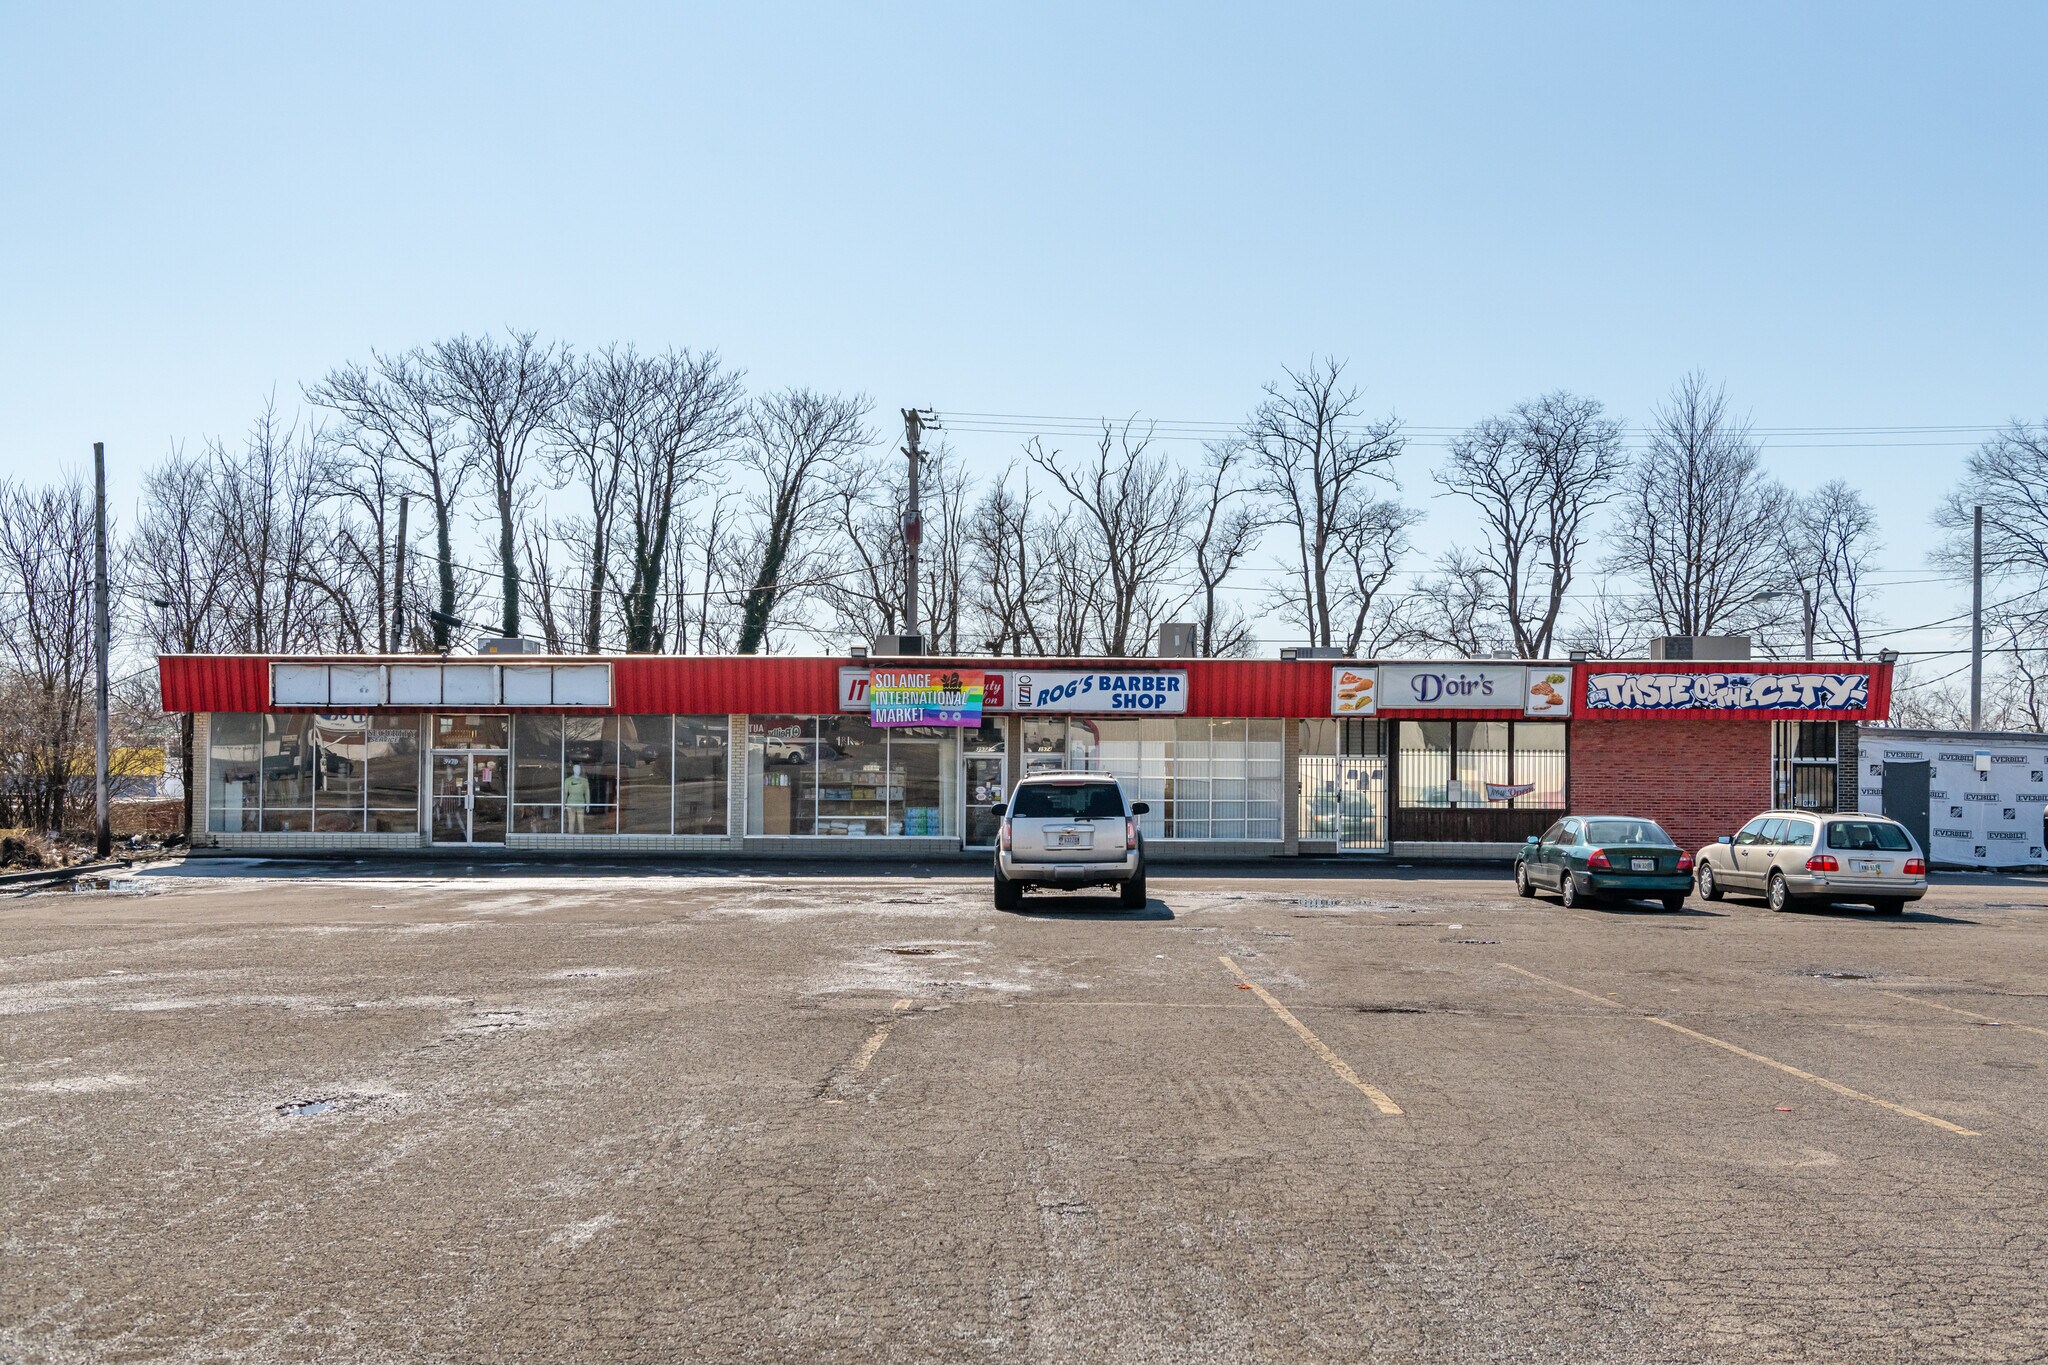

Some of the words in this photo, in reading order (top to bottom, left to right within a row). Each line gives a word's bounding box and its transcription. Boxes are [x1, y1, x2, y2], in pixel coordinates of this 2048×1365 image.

[875, 673, 931, 688] SOLANGE
[1036, 674, 1094, 707] ROG'S
[1099, 676, 1180, 691] BARBER
[1411, 673, 1494, 702] D'oir's
[1590, 675, 1692, 706] TASTE
[1694, 674, 1726, 701] OF
[1751, 675, 1866, 707] CITY
[875, 691, 968, 706] INTERNATIONAL
[1112, 693, 1167, 709] SHOP
[1708, 687, 1757, 708] THE
[875, 708, 925, 722] MARKET
[1940, 753, 1974, 761] EVERBIL
